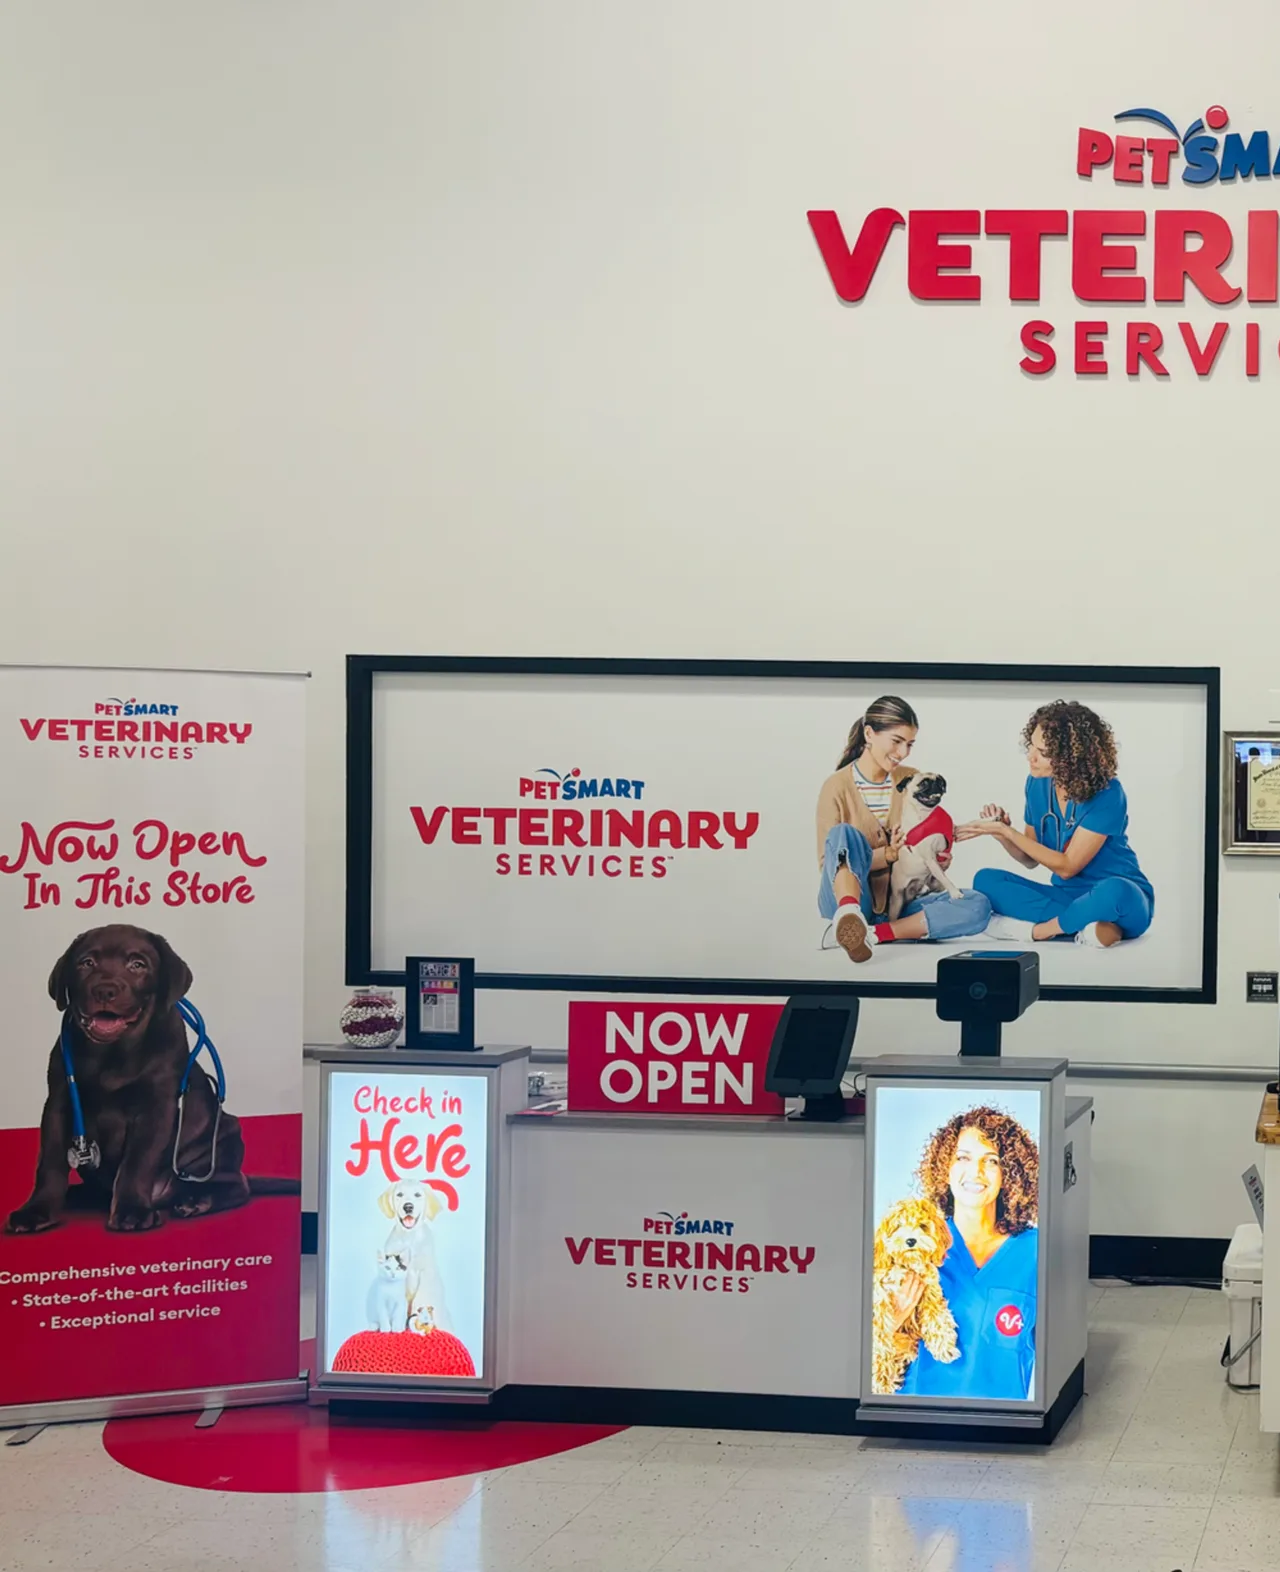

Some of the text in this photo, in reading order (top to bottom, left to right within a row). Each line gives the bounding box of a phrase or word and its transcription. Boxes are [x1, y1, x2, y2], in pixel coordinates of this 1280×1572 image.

[95, 701, 179, 717] PETSMART
[20, 716, 252, 744] VETERINARY
[519, 774, 645, 801] PETSMART
[410, 805, 760, 850] VETERINARY
[0, 818, 268, 874] Now Open
[23, 866, 256, 910] In This Store
[604, 1010, 751, 1056] NOW
[599, 1060, 755, 1105] OPEN
[353, 1085, 462, 1119] Check in
[345, 1116, 471, 1212] Here
[643, 1216, 735, 1237] PETSMART
[0, 1254, 273, 1286] Comprehensive veterinary care
[564, 1236, 816, 1275] VETERINARY
[22, 1277, 248, 1308] State-of-the-art facilities
[50, 1304, 222, 1330] Exceptional service
